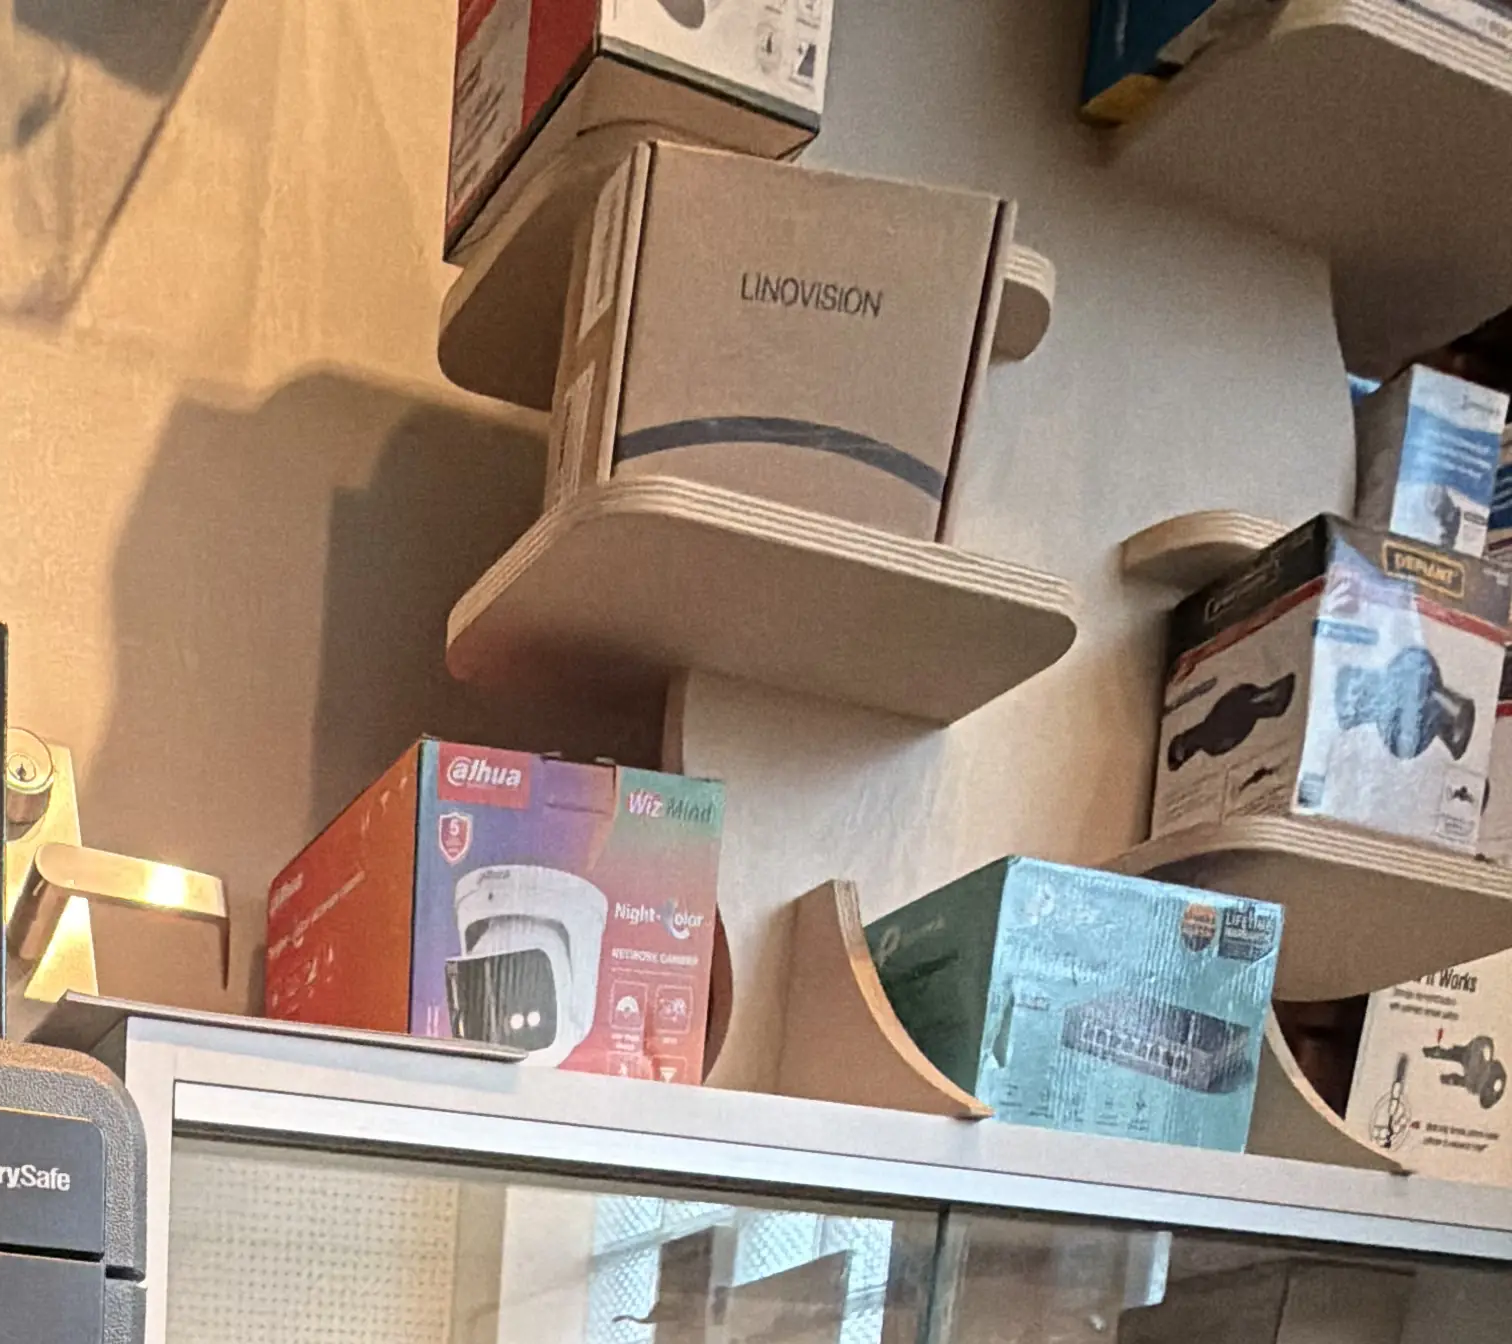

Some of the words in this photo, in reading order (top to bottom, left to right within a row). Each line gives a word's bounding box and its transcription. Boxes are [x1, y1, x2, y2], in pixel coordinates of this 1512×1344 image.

[741, 272, 883, 318] LINOVISION
[449, 818, 459, 835] 5
[1439, 968, 1477, 992] Works
